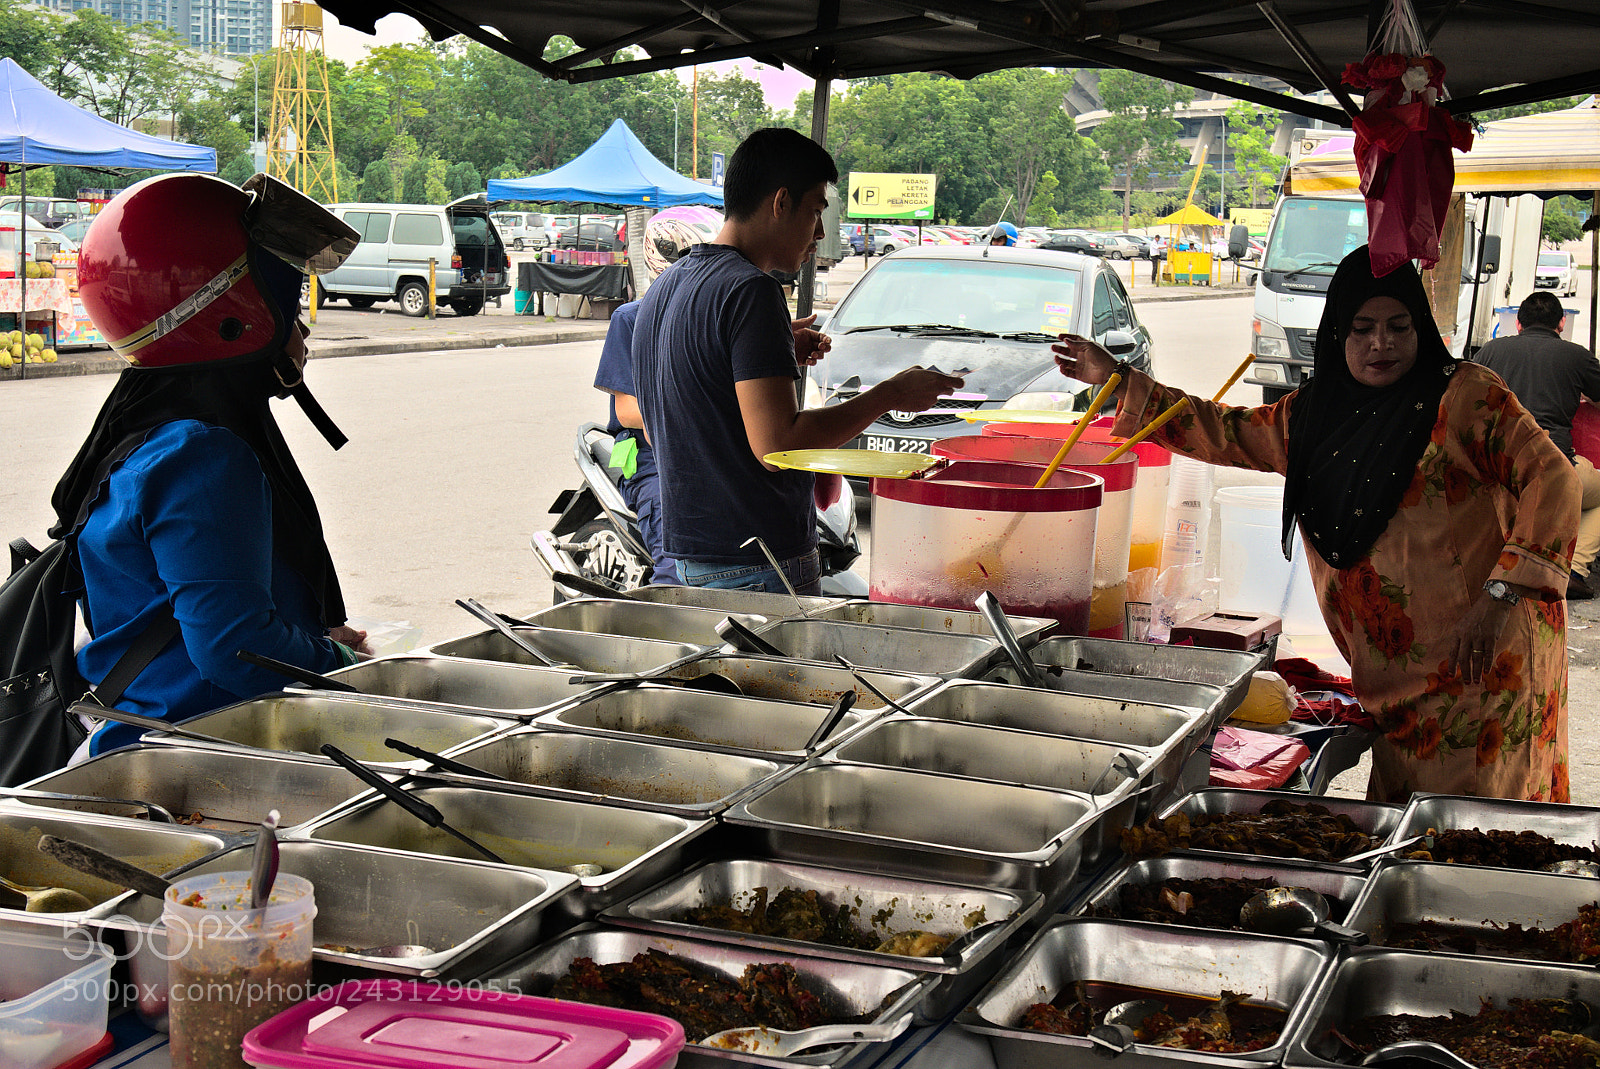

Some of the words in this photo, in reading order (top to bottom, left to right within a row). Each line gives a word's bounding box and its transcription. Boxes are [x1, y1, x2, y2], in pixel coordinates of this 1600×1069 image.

[714, 156, 723, 182] P
[866, 190, 875, 202] P
[867, 436, 896, 453] BHQ
[899, 439, 928, 455] 222
